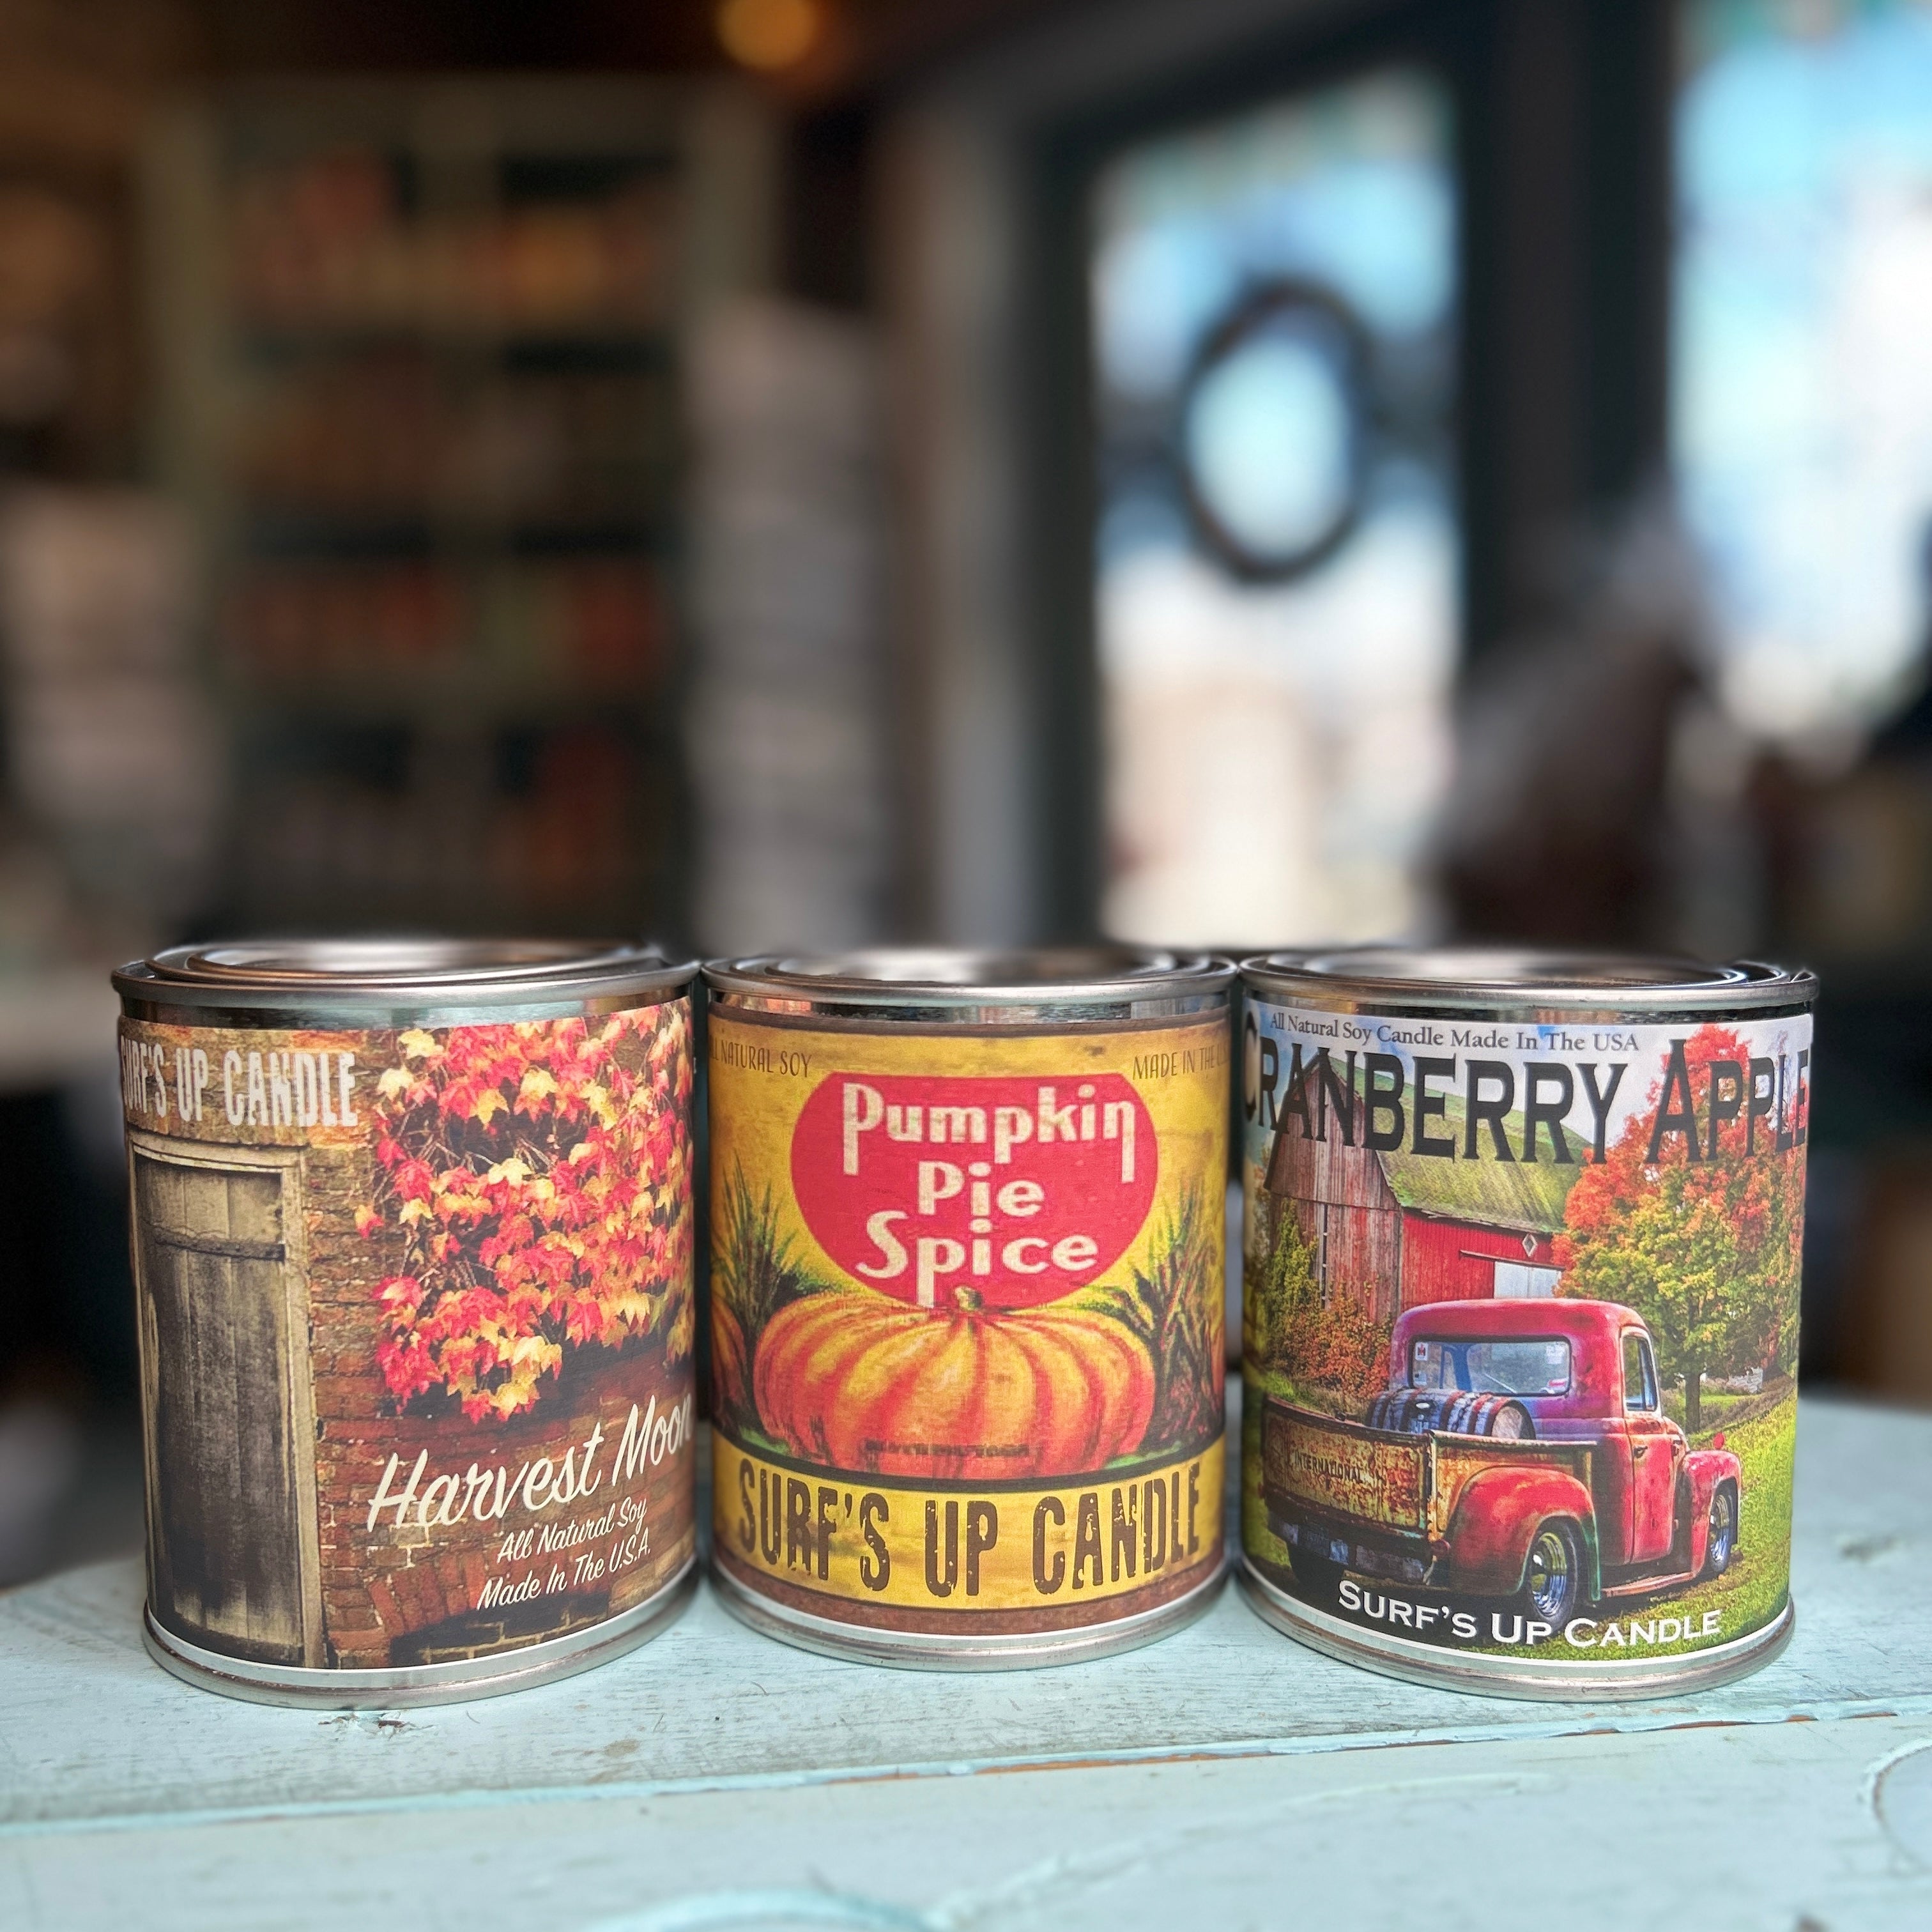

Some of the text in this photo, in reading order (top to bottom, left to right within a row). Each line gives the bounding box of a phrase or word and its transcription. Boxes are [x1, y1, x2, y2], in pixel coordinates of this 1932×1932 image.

[721, 1039, 774, 1073] NATURAL
[779, 1050, 813, 1078] SOY
[1133, 1052, 1178, 1080] MADE
[1183, 1048, 1195, 1075] IN
[1199, 1045, 1215, 1071] THE
[1270, 1011, 1640, 1052] All Natural Soy Candle Made In The USA
[120, 1035, 359, 1128] SURF'S UP CANDLE
[1246, 1010, 1809, 1164] CRANBERRY APPLE
[842, 1081, 1135, 1183] Pumpkin
[917, 1160, 1046, 1216] Pie
[856, 1210, 1099, 1309] Spice
[367, 1393, 692, 1533] Harvest Moon
[477, 1527, 651, 1611] Made In The U.S.A.
[496, 1496, 647, 1565] All Natural Soy
[739, 1458, 1200, 1598] SURF'S UP CANDLE
[1338, 1579, 1721, 1648] SURF'S UP CANDLE
